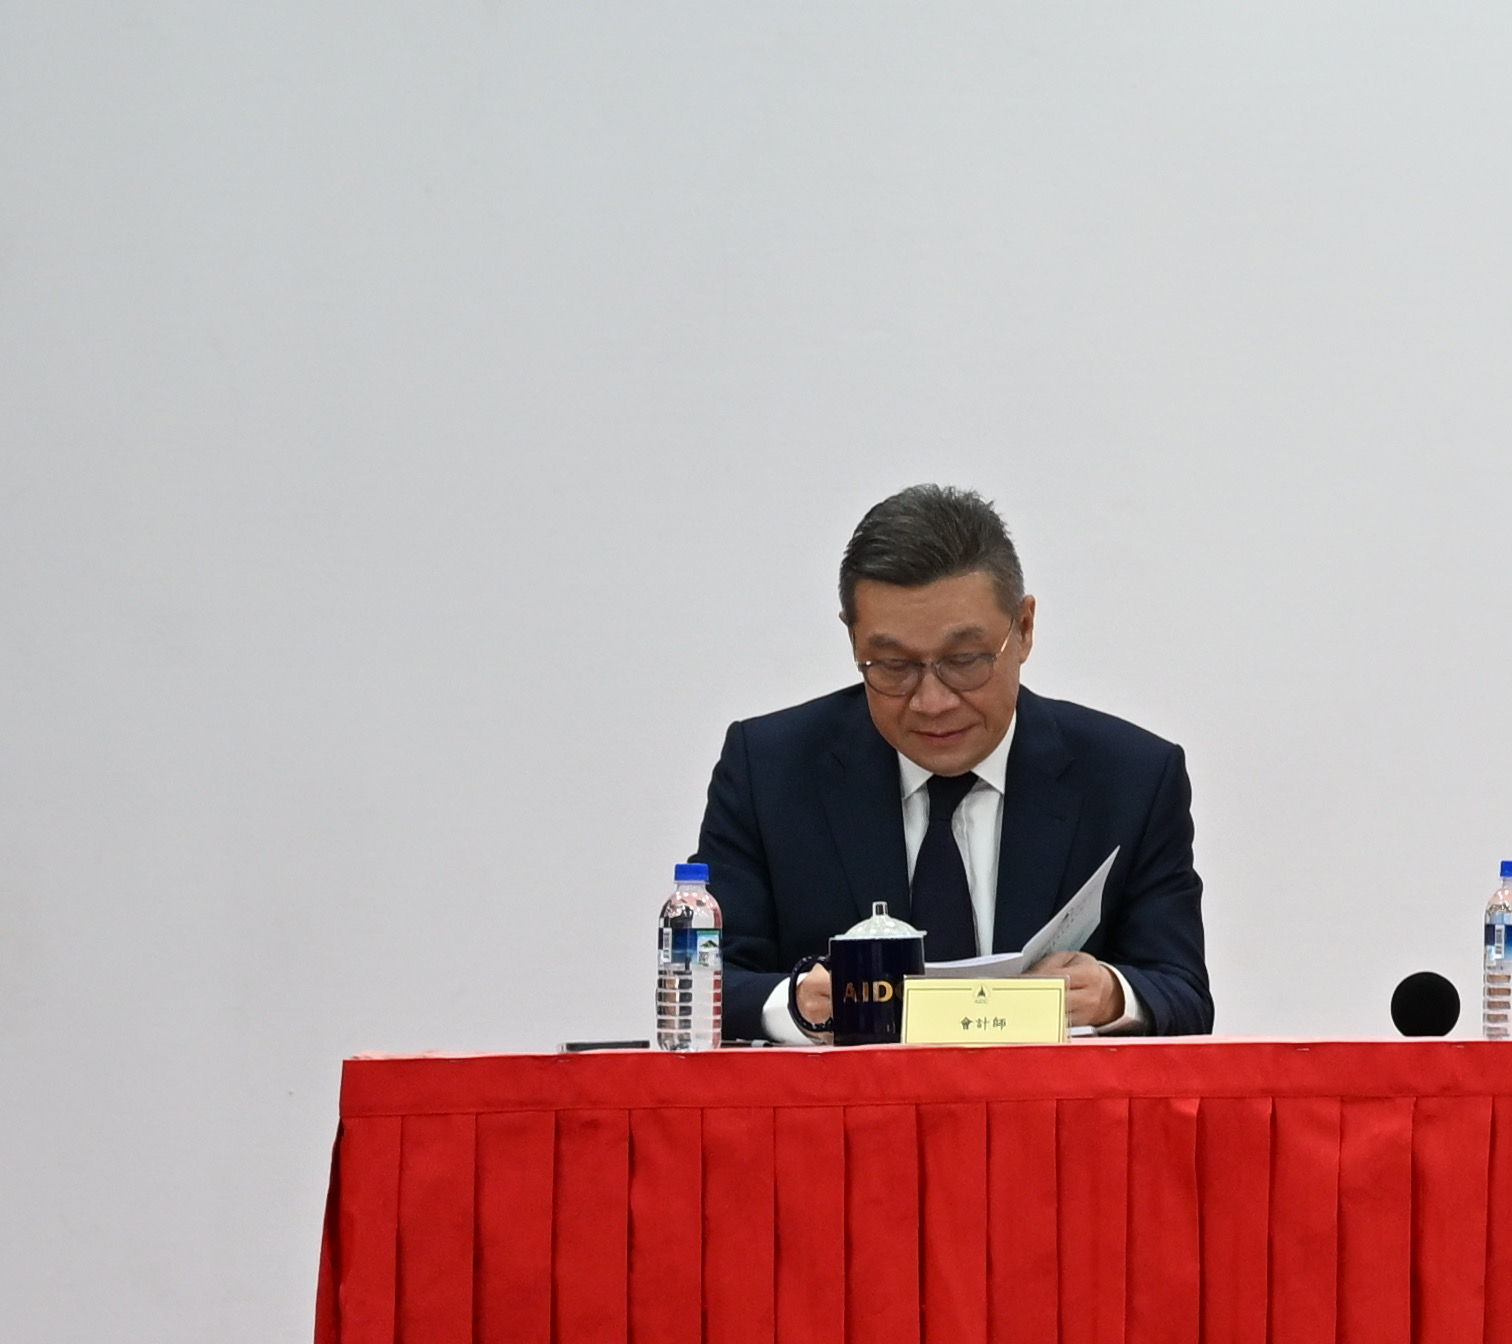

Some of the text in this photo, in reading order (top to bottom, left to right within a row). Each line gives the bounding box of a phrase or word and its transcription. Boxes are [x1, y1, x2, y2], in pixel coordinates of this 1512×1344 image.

[843, 980, 903, 1003] AID
[960, 1016, 1006, 1031] 會計師
